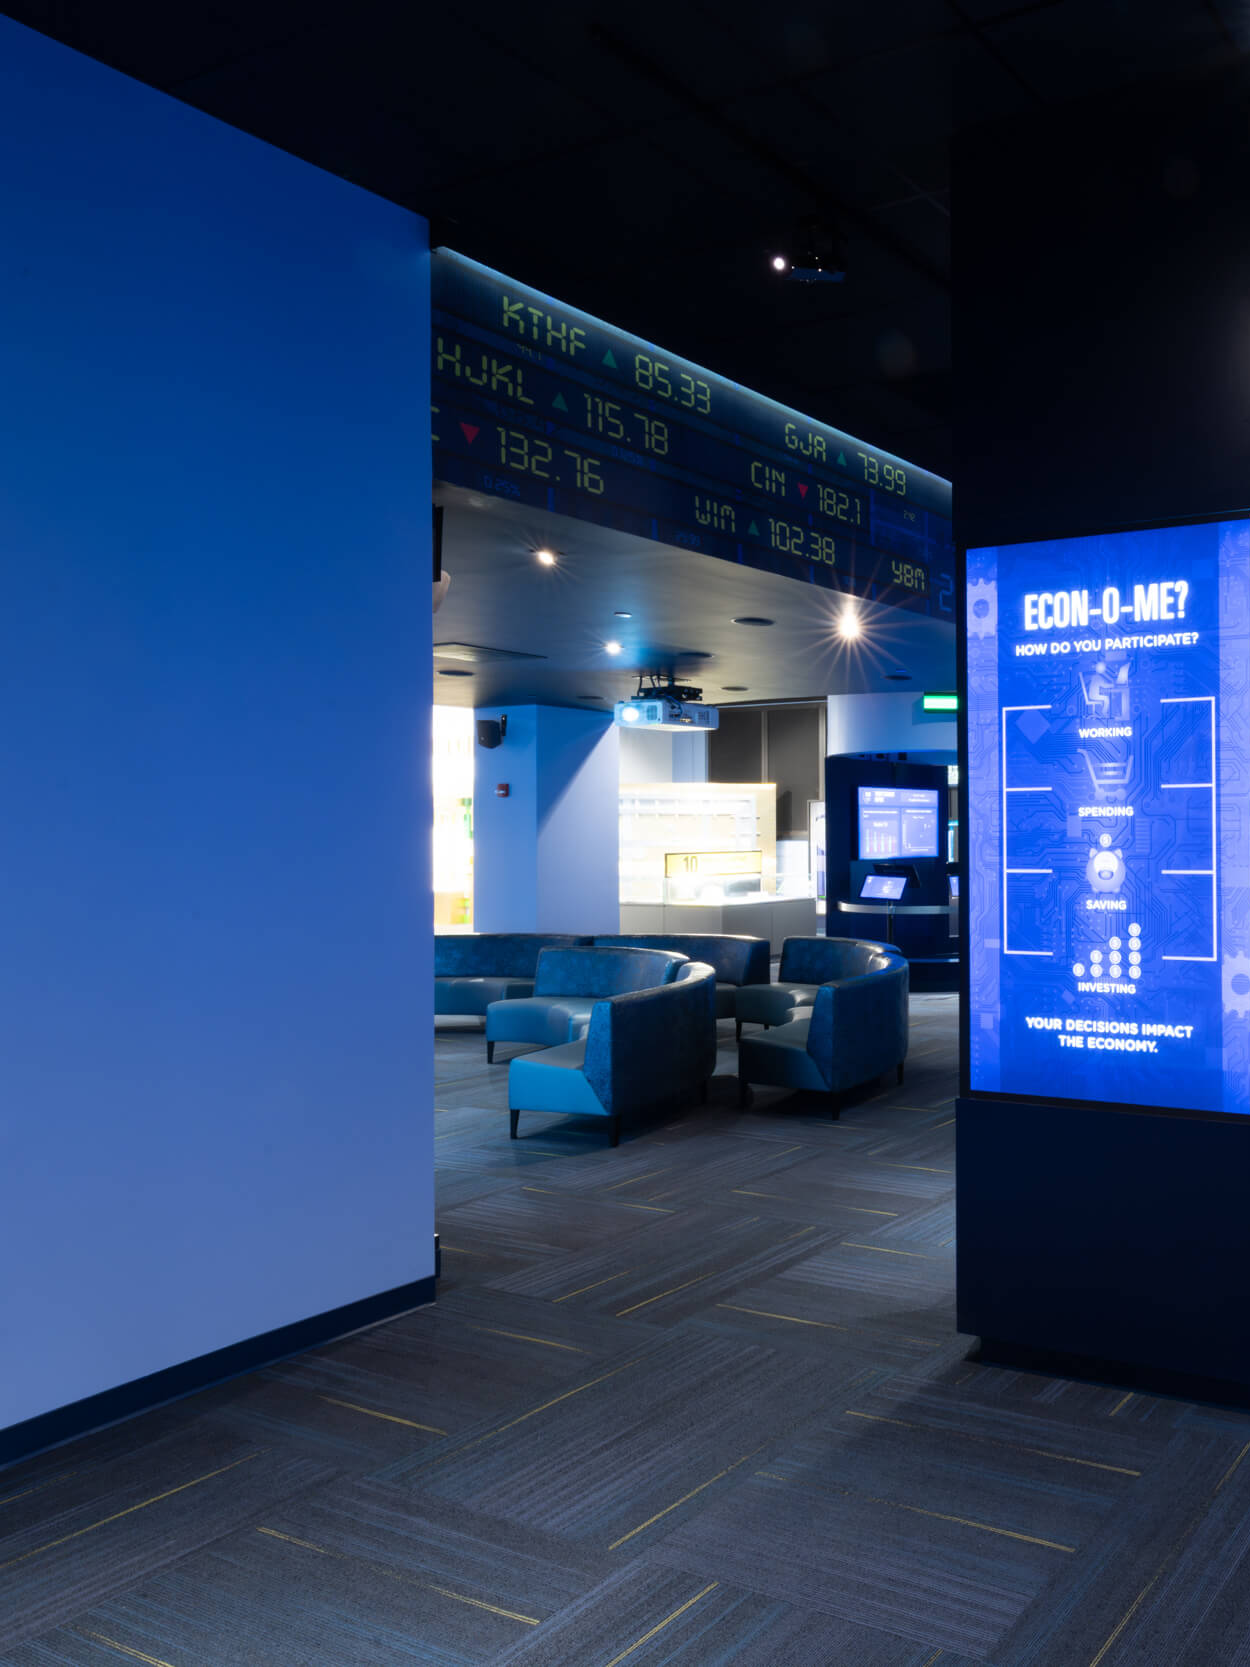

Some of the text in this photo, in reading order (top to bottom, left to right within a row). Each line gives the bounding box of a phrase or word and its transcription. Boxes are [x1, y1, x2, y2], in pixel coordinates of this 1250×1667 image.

[502, 295, 711, 415] KTHF 85.33
[436, 336, 669, 456] HJKL 115.78
[496, 426, 605, 495] 132.76
[784, 423, 907, 496] GJA 73.99
[751, 460, 861, 525] CIN 182.1
[768, 517, 836, 566] 102.38
[1024, 580, 1190, 631] ECON-O-ME?
[1015, 631, 1200, 657] HOW DO YOU PARTICIPATE?
[1078, 727, 1133, 739] WORKING
[1078, 806, 1134, 818] SPENDING
[1086, 900, 1127, 911] SAVING
[1077, 982, 1137, 995] INVESTING
[1025, 1016, 1194, 1039] YOUR DECISIONS IMPACT
[1058, 1034, 1159, 1053] THE ECONOMY.
